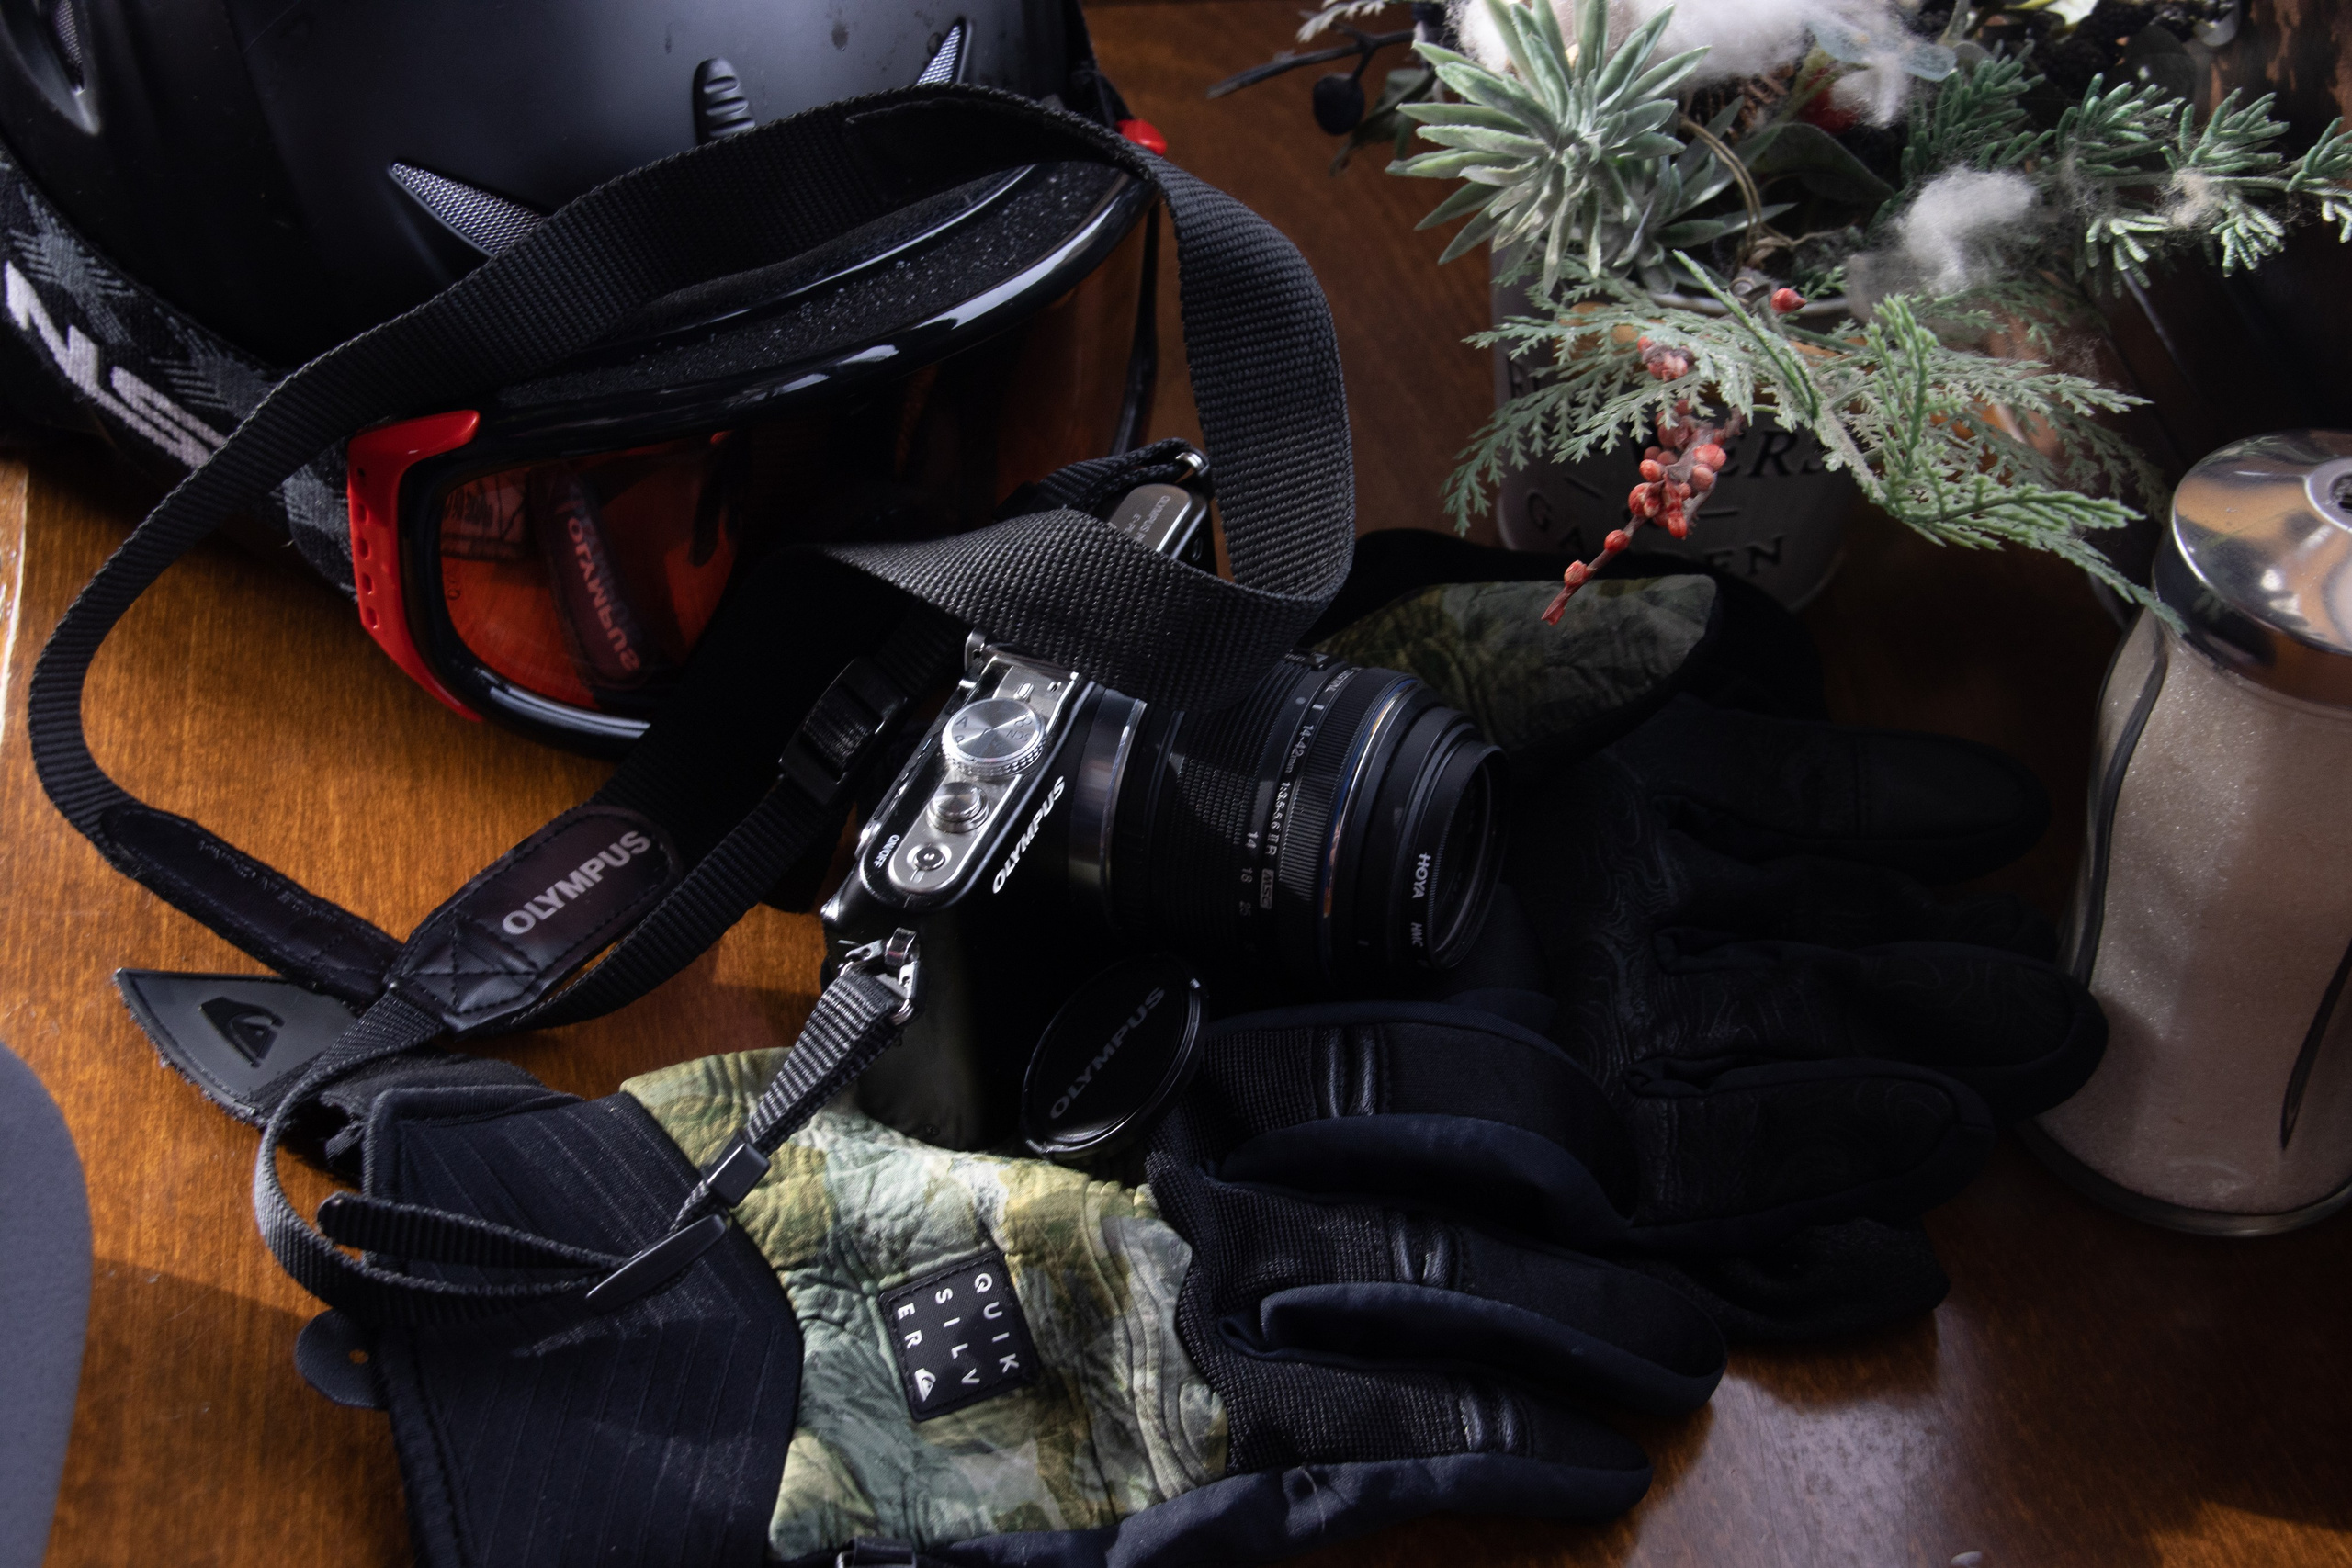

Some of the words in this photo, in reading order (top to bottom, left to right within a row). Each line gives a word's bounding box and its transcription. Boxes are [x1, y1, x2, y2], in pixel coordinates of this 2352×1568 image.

[502, 829, 651, 935] OLYMPUS
[992, 776, 1066, 895] OLYMPUS
[1239, 867, 1254, 884] 18
[1244, 831, 1260, 850] 14
[1411, 852, 1432, 899] HOYA
[1049, 986, 1166, 1120] OLYMPUS
[897, 1302, 923, 1349] ER
[935, 1287, 981, 1385] SILV
[975, 1272, 1020, 1374] QUIK
